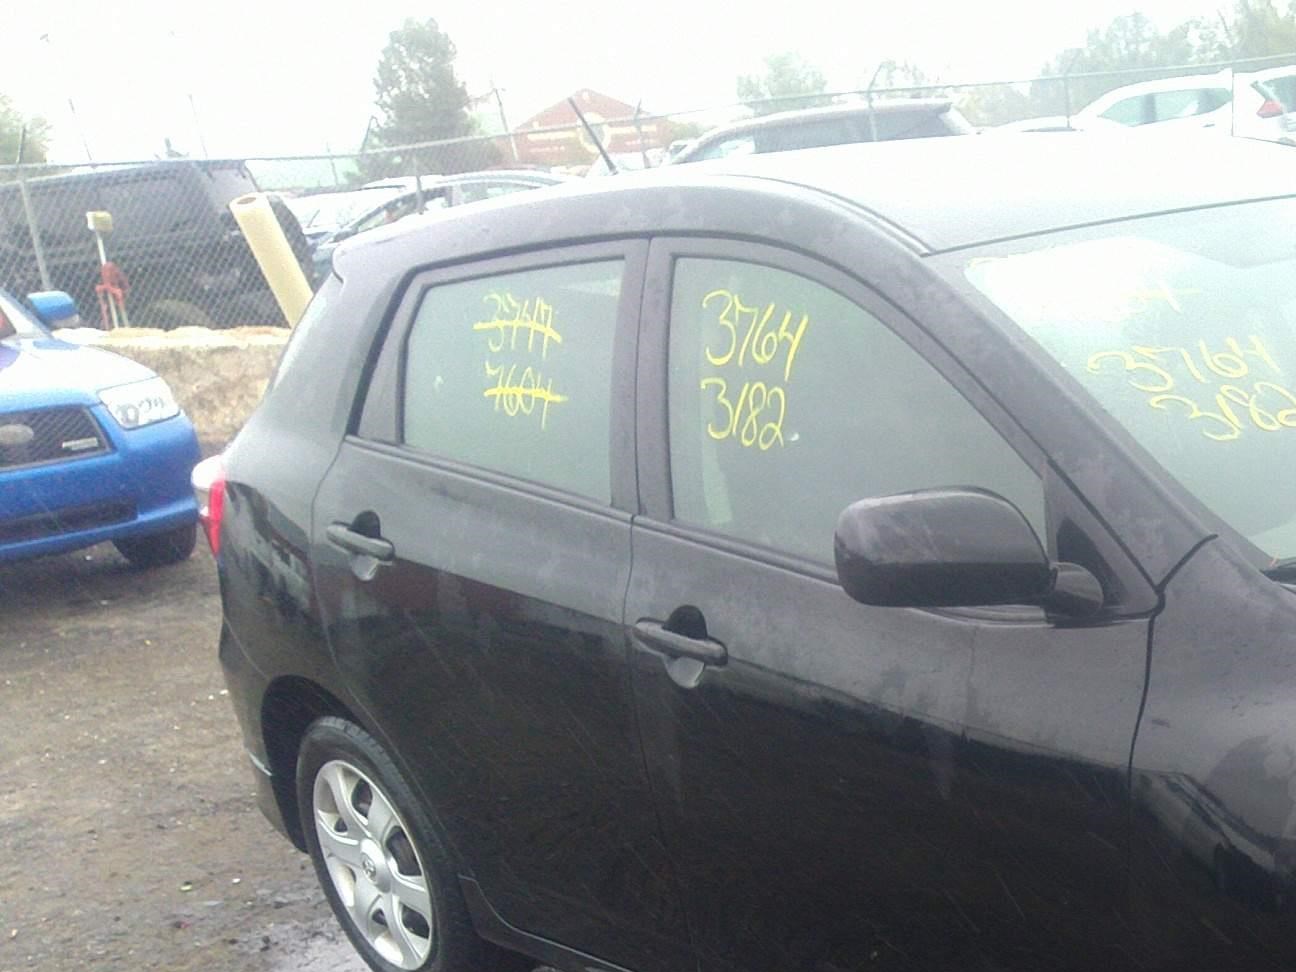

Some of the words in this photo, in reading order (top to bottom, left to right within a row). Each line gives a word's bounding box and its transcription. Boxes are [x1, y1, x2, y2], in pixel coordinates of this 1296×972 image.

[702, 288, 809, 382] 3764
[1086, 334, 1282, 394] 3764
[700, 377, 785, 450] 3182
